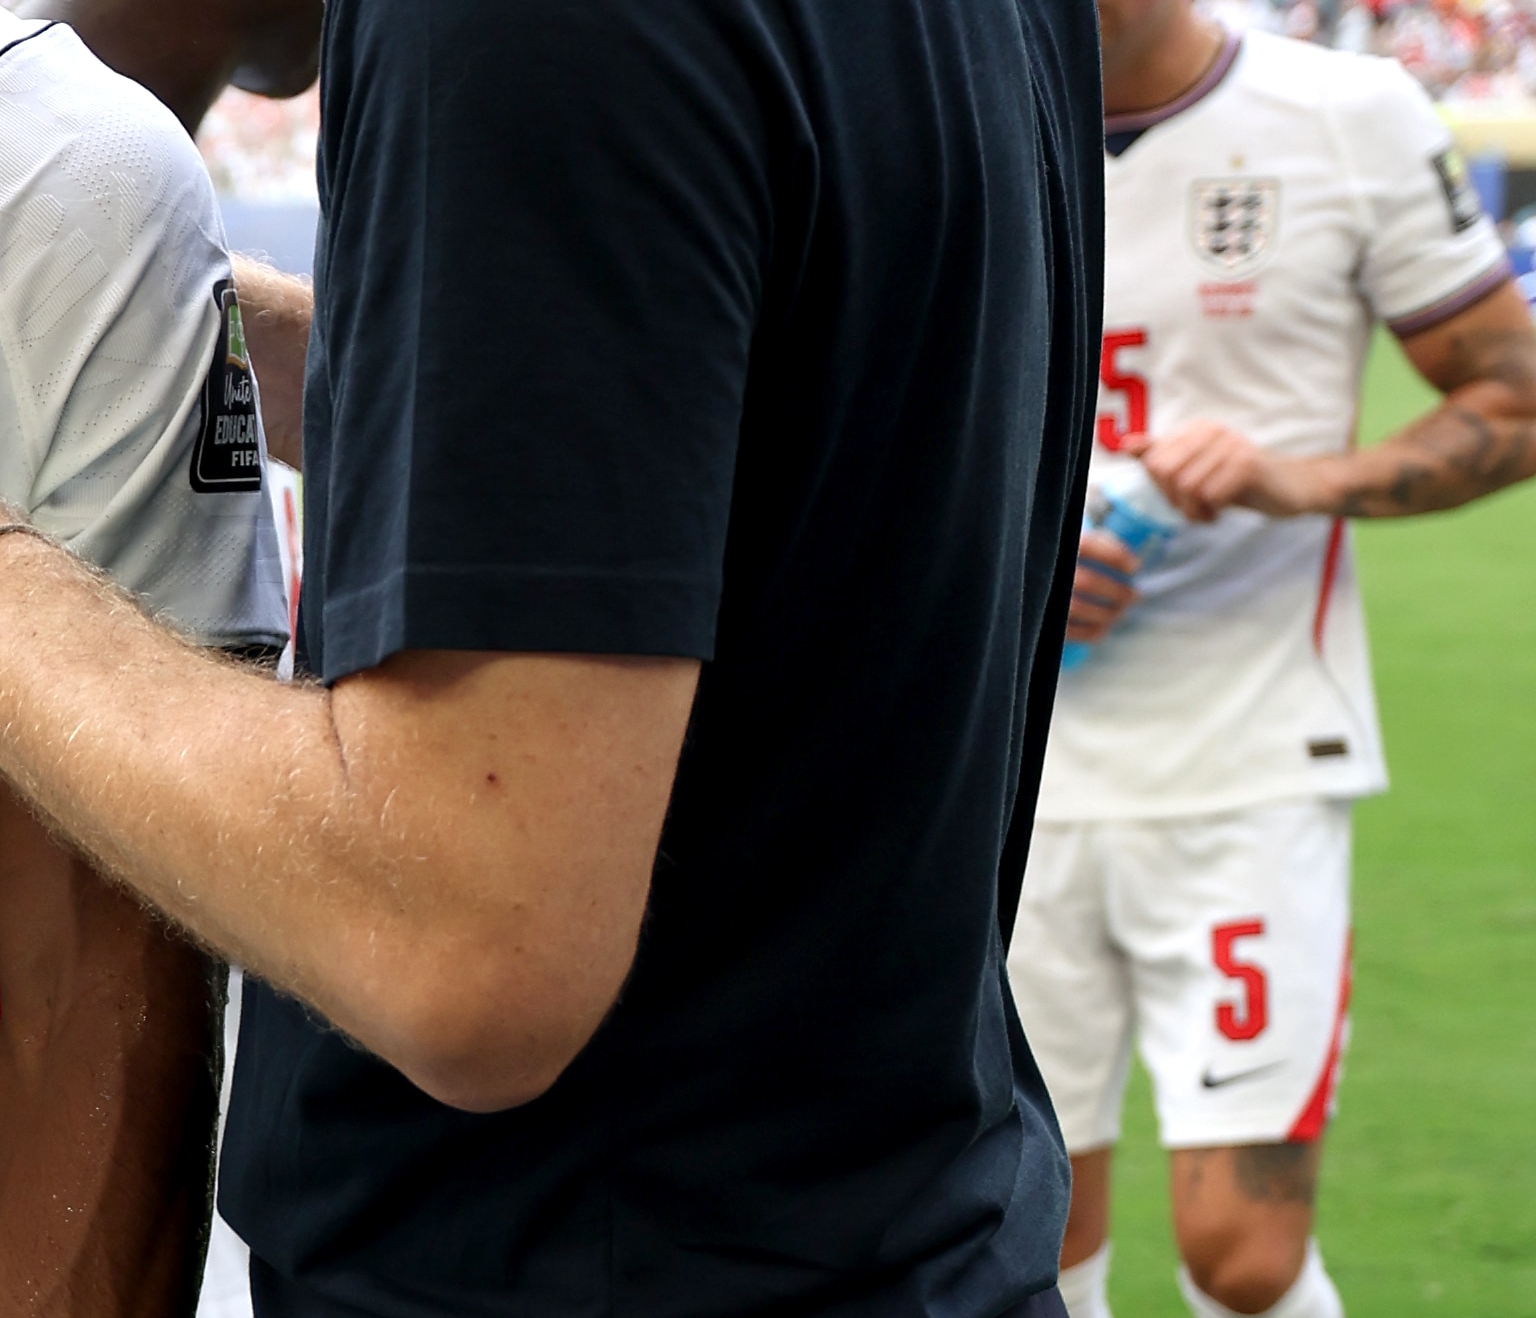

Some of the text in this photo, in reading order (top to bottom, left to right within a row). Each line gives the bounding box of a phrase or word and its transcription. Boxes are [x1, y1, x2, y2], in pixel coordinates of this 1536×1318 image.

[214, 414, 256, 445] EDUCA
[1097, 327, 1149, 453] 5
[1210, 917, 1268, 1043] 5
